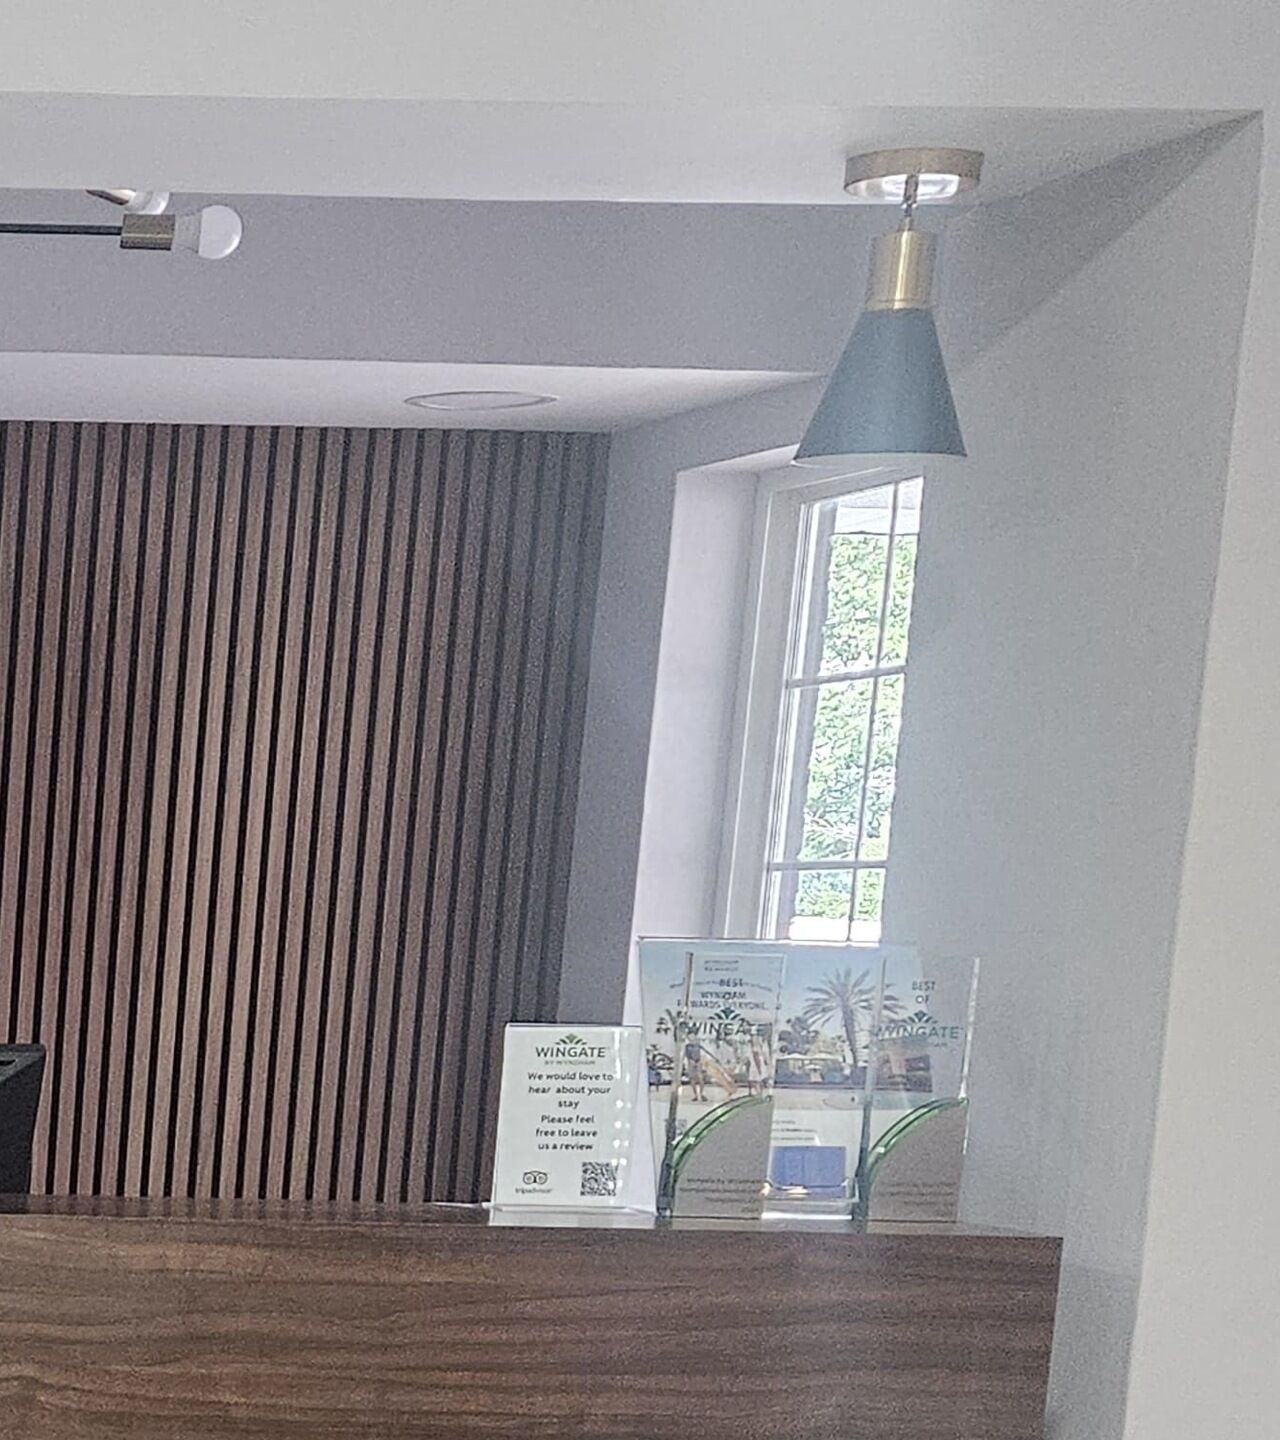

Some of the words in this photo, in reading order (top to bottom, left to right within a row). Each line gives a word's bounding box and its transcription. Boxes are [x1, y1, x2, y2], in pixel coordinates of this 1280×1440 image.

[912, 981, 936, 991] BEST
[535, 1046, 606, 1058] WINGATE
[528, 1072, 543, 1081] We
[546, 1072, 576, 1080] would
[578, 1072, 601, 1080] love
[603, 1073, 614, 1081] to
[528, 1086, 551, 1094] hear
[556, 1085, 586, 1094] about
[587, 1087, 611, 1097] your
[558, 1100, 580, 1110] stay
[541, 1114, 574, 1124] Please
[575, 1114, 595, 1124] feel
[536, 1128, 556, 1137] free
[558, 1129, 569, 1137] to
[571, 1128, 598, 1137] leave
[560, 1141, 594, 1150] review
